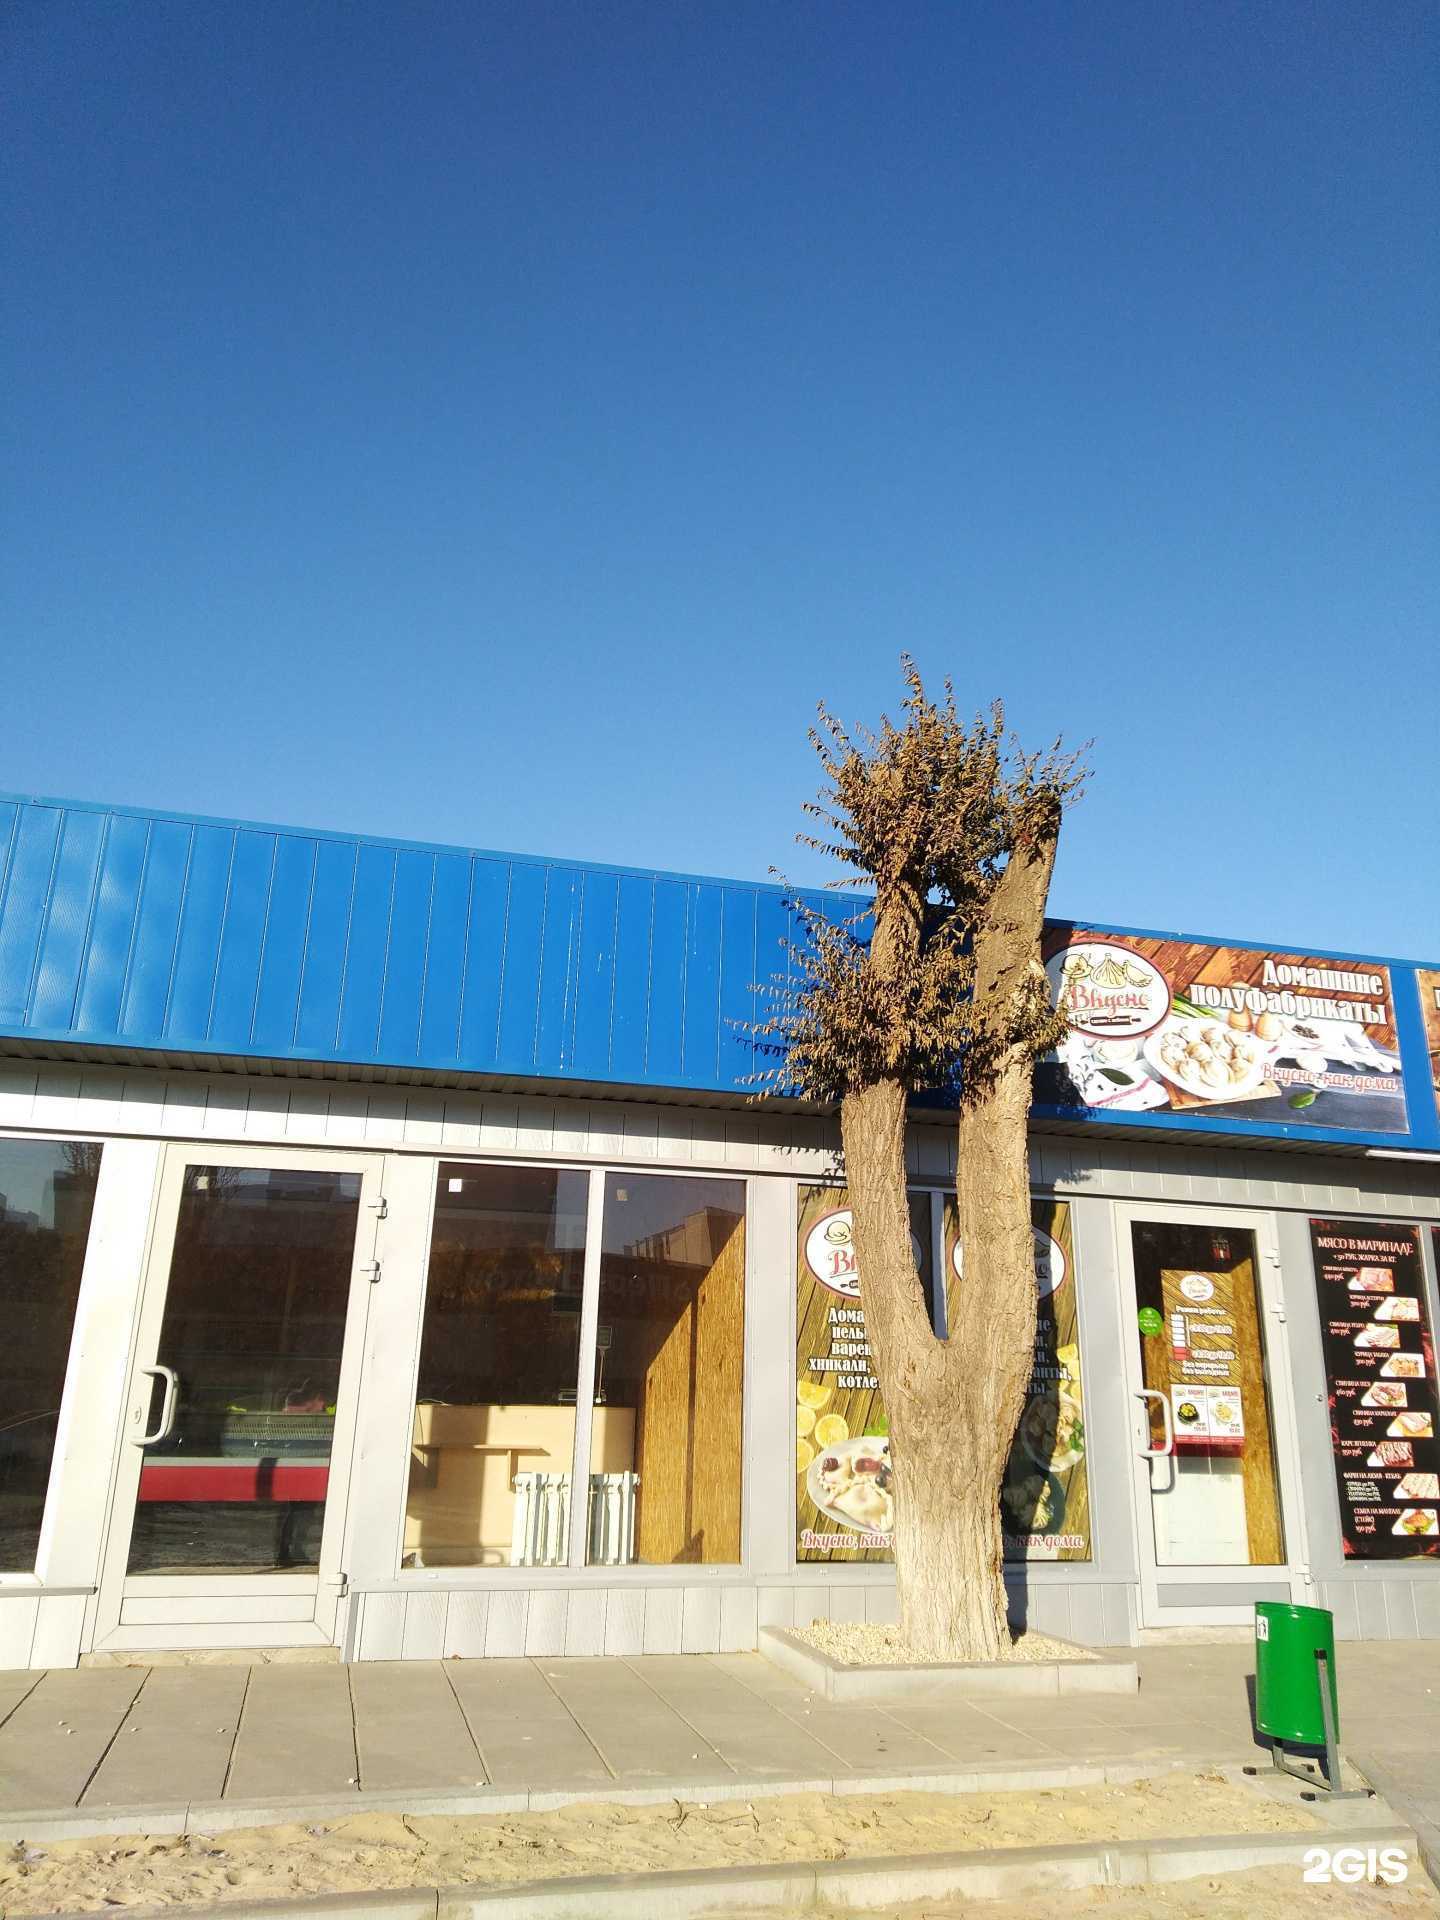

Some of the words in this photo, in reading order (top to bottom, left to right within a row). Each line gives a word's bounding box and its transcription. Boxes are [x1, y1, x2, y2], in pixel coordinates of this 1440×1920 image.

[1263, 960, 1384, 996] Домашние
[1190, 982, 1387, 1024] полуфабрикаты
[1323, 1072, 1353, 1087] как
[1317, 1237, 1347, 1249] МЯСО
[1348, 1239, 1357, 1249] В
[1357, 1240, 1414, 1256] МАРИНАДЕ
[828, 1307, 865, 1324] Дома
[832, 1326, 867, 1340] пель
[832, 1343, 871, 1358] варен
[809, 1358, 871, 1374] хинкали,
[1032, 1367, 1073, 1381] анты,
[838, 1375, 880, 1390] котле
[801, 1530, 859, 1552] Вкусно,
[861, 1534, 891, 1549] как
[1044, 1535, 1084, 1550] дома
